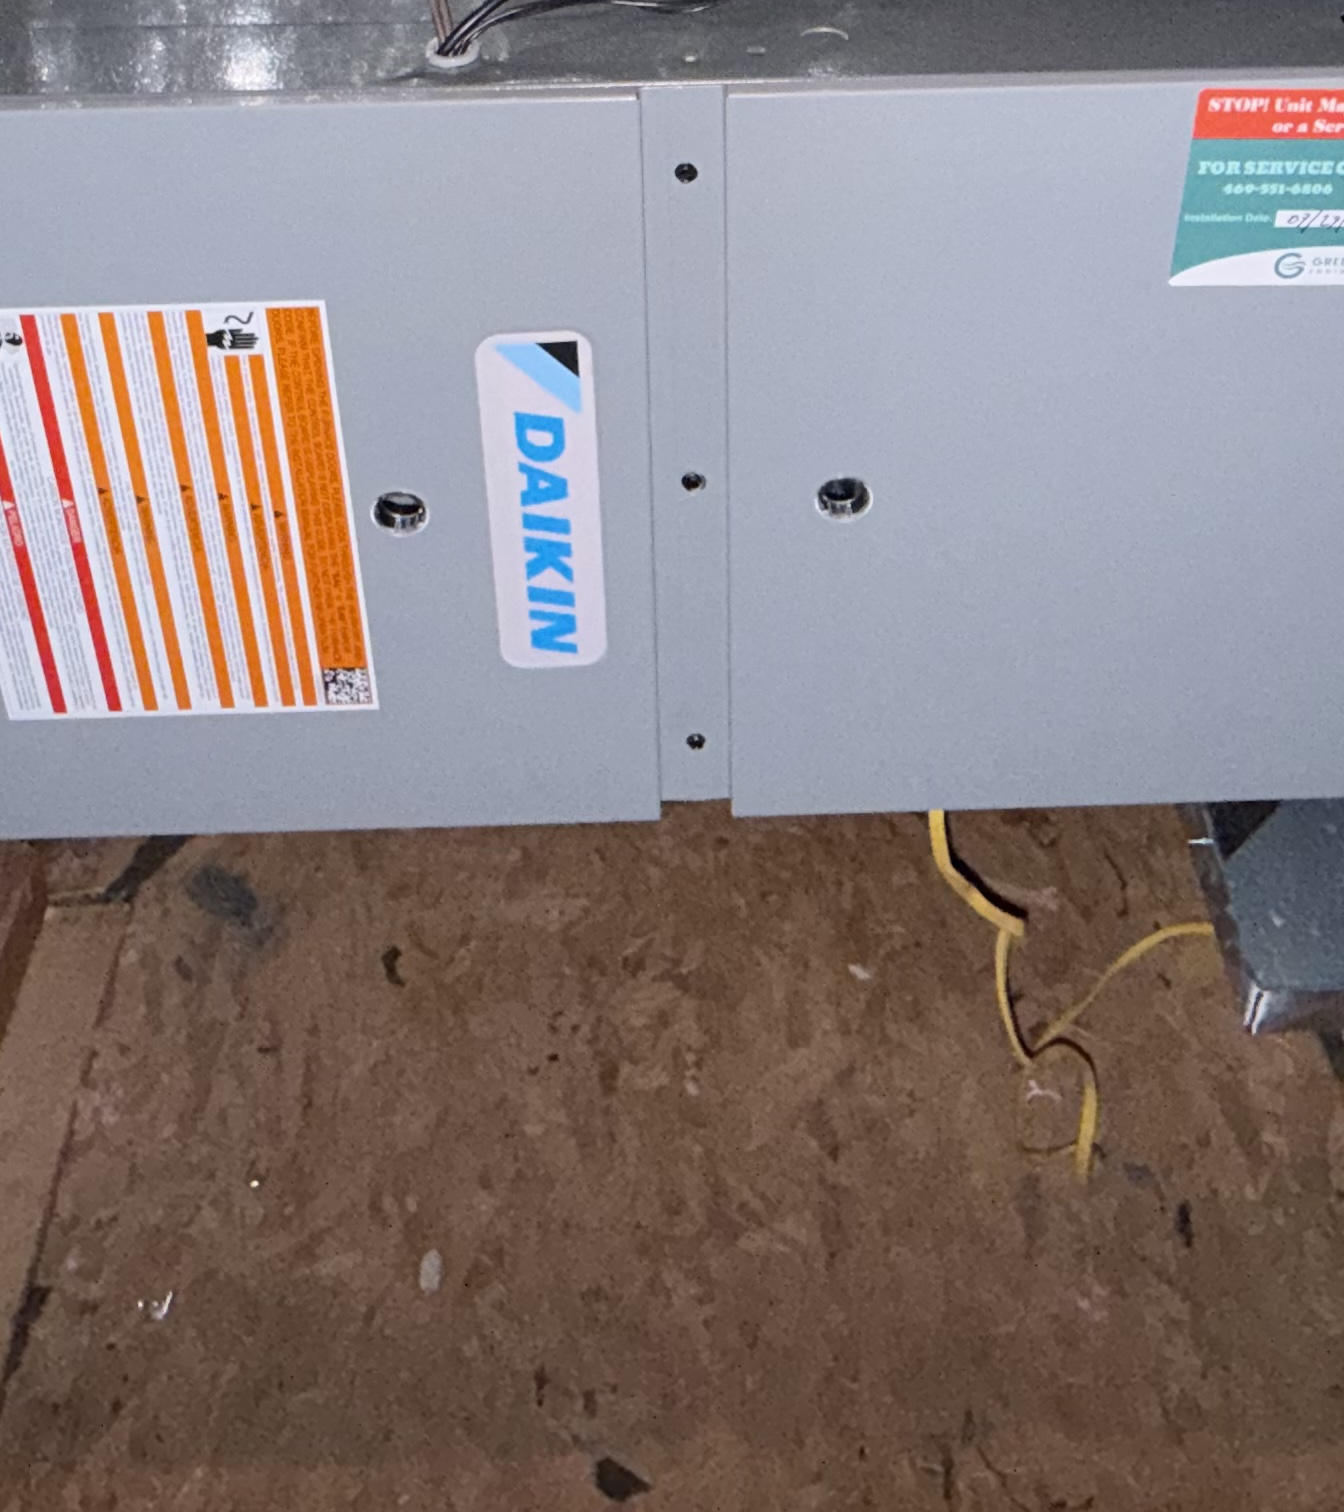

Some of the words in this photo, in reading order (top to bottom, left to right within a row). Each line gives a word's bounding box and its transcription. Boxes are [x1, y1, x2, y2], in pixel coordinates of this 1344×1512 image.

[1208, 97, 1270, 112] STOP!
[1274, 97, 1313, 112] Unit
[1272, 122, 1293, 133] or
[1296, 122, 1308, 133] a
[1197, 161, 1241, 175] FOR
[1242, 161, 1334, 175] SERVICE
[513, 411, 579, 655] DAIKIN
